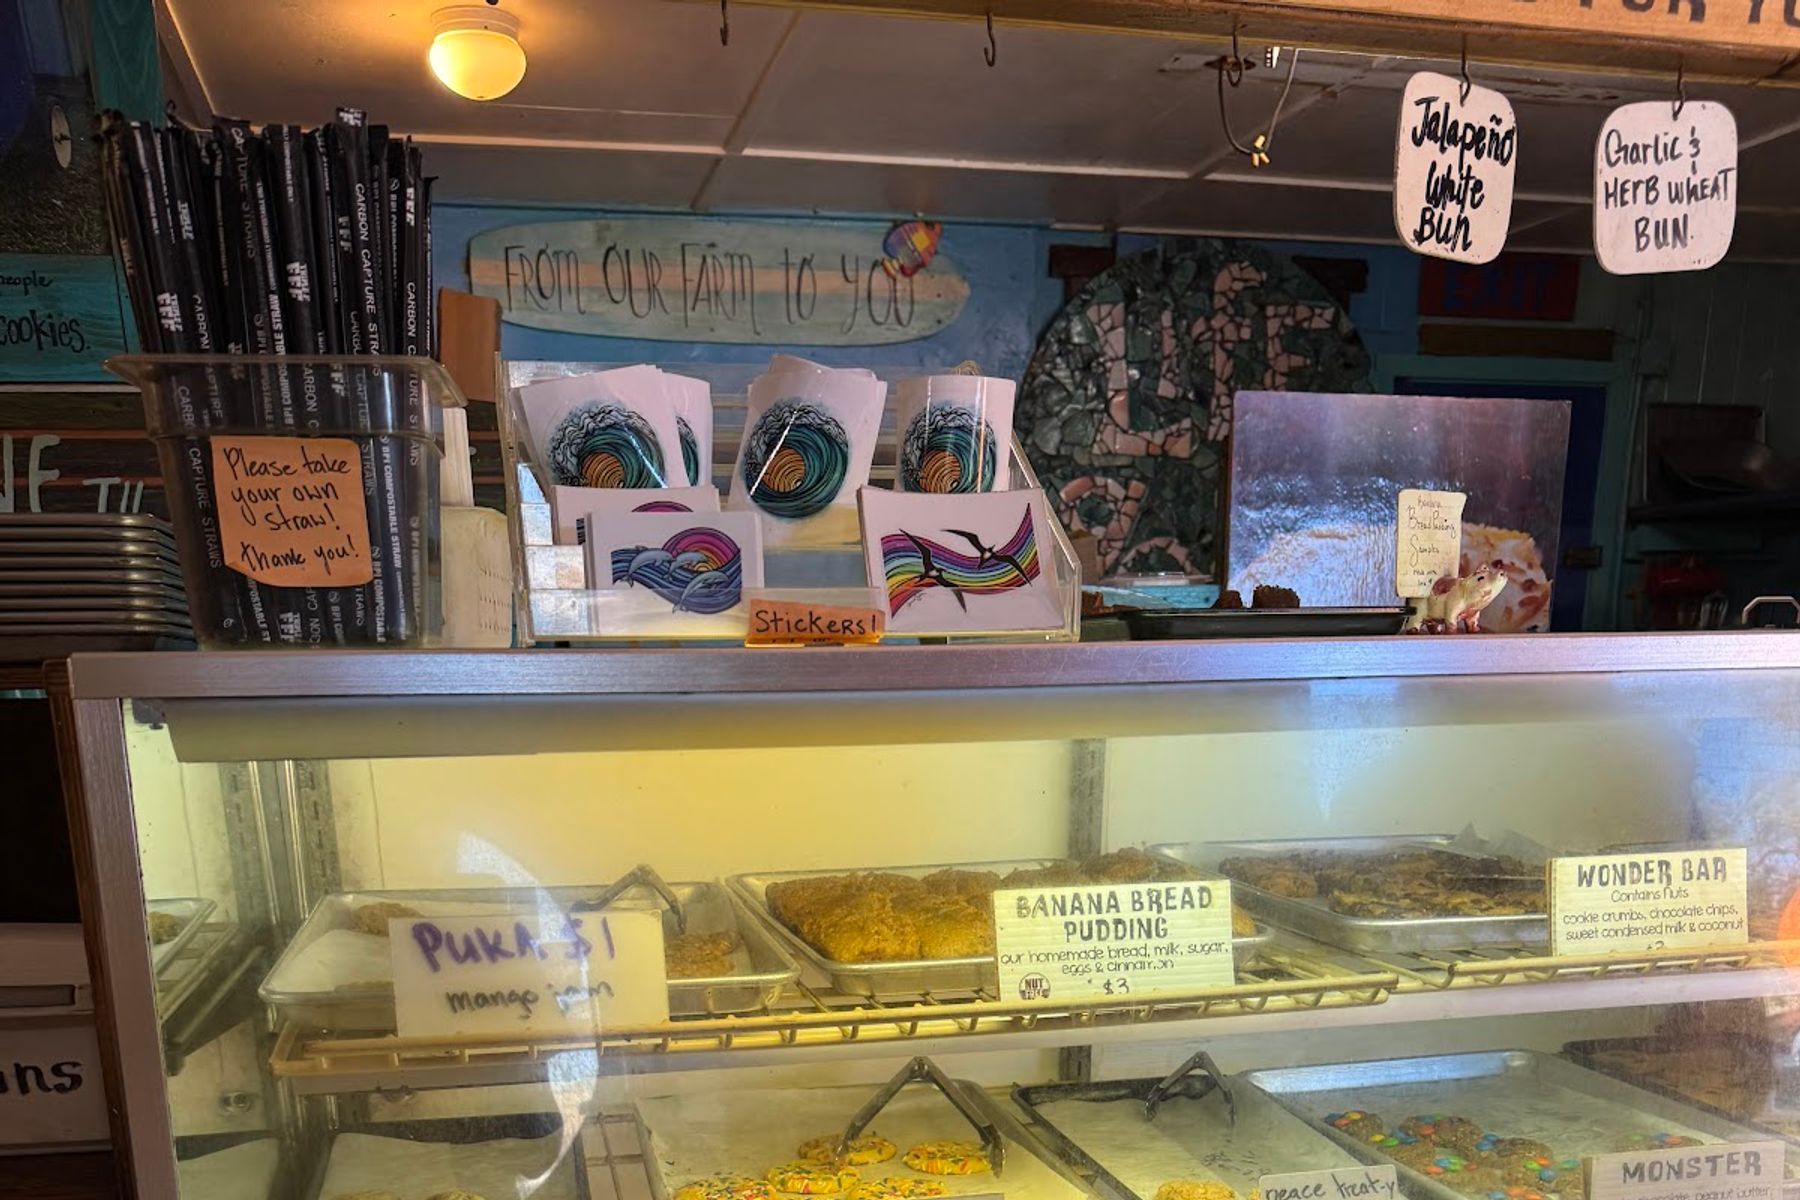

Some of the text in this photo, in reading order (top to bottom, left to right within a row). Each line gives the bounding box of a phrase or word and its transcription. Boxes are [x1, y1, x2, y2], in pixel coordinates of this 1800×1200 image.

[1412, 97, 1516, 166] Jalapeño
[1605, 129, 1682, 167] Garlic
[1427, 162, 1484, 209] White
[355, 183, 369, 241] CARBON
[1413, 207, 1472, 252] Bun
[1635, 214, 1688, 252] BUN
[361, 249, 376, 314] CAPTURE
[503, 242, 587, 315] FROM
[603, 241, 671, 319] OUR
[680, 241, 762, 335] FARM
[407, 282, 417, 337] CARBON
[368, 322, 382, 376] STRAS
[273, 332, 292, 405] COMPOSABLE
[224, 446, 351, 480] Please take
[190, 448, 210, 509] CAPTURE
[201, 516, 222, 569] STRAWS
[231, 482, 338, 526] your own
[265, 503, 340, 531] straw!
[383, 465, 399, 535] COMPOSTABLE
[391, 535, 403, 569] STRAW
[314, 535, 359, 576] you!
[1578, 857, 1727, 887] WONDER BAR
[1016, 886, 1212, 919] BANANA BREAD
[1611, 889, 1661, 903] Contains
[1064, 917, 1168, 942] PUDDING
[1563, 913, 1599, 925] cookie
[1566, 928, 1598, 940] sweet
[1601, 923, 1663, 938] condensed
[1665, 921, 1685, 934] milk
[1698, 919, 1743, 931] coconut
[1001, 953, 1024, 964] our
[1029, 947, 1104, 963] homemade
[1108, 943, 1150, 959] bread,
[1154, 943, 1183, 956] milk,
[1062, 962, 1091, 975] eggs
[1024, 978, 1044, 990] NUT
[1103, 978, 1129, 995] $3
[446, 990, 540, 1020] mango
[1622, 1151, 1761, 1184] MONSTER
